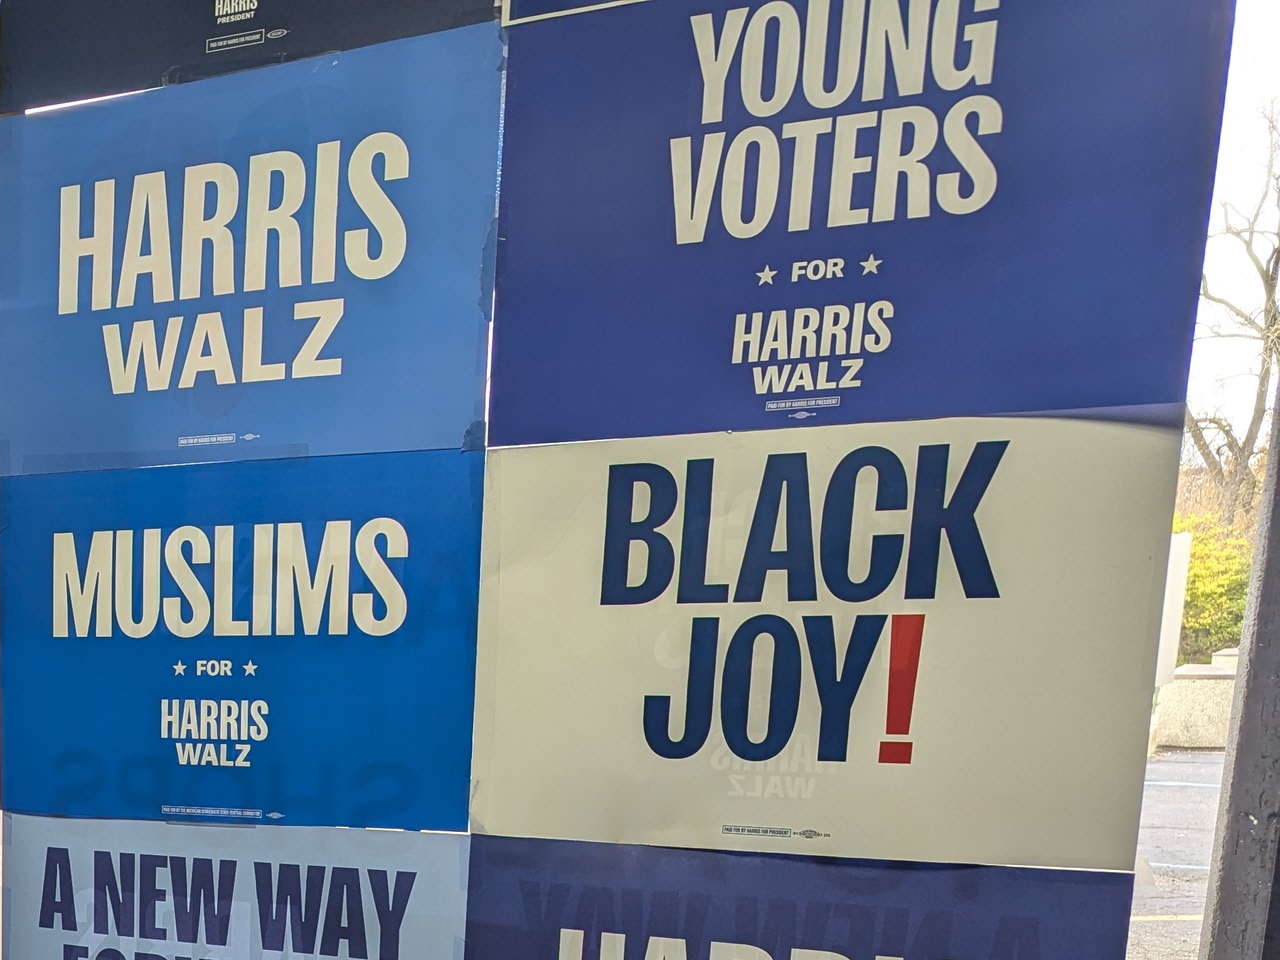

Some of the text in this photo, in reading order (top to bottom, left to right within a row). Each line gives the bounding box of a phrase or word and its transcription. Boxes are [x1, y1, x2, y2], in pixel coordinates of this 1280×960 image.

[217, 11, 255, 24] PRESIDENT
[689, 0, 1000, 124] YOUNG
[669, 94, 1003, 245] VOTERS
[57, 131, 410, 316] HARRIS
[790, 257, 845, 283] FOR
[102, 298, 344, 394] WALZ
[731, 300, 895, 364] HARRIS
[752, 357, 863, 395] WALZ
[599, 440, 1011, 606] BLACK
[52, 517, 409, 639] MUSLIMS
[195, 659, 233, 677] FOR
[642, 613, 926, 765] JOY!
[160, 698, 269, 742] HARRIS
[175, 742, 251, 768] WALZ
[38, 846, 78, 932] A
[93, 849, 238, 947] NEW
